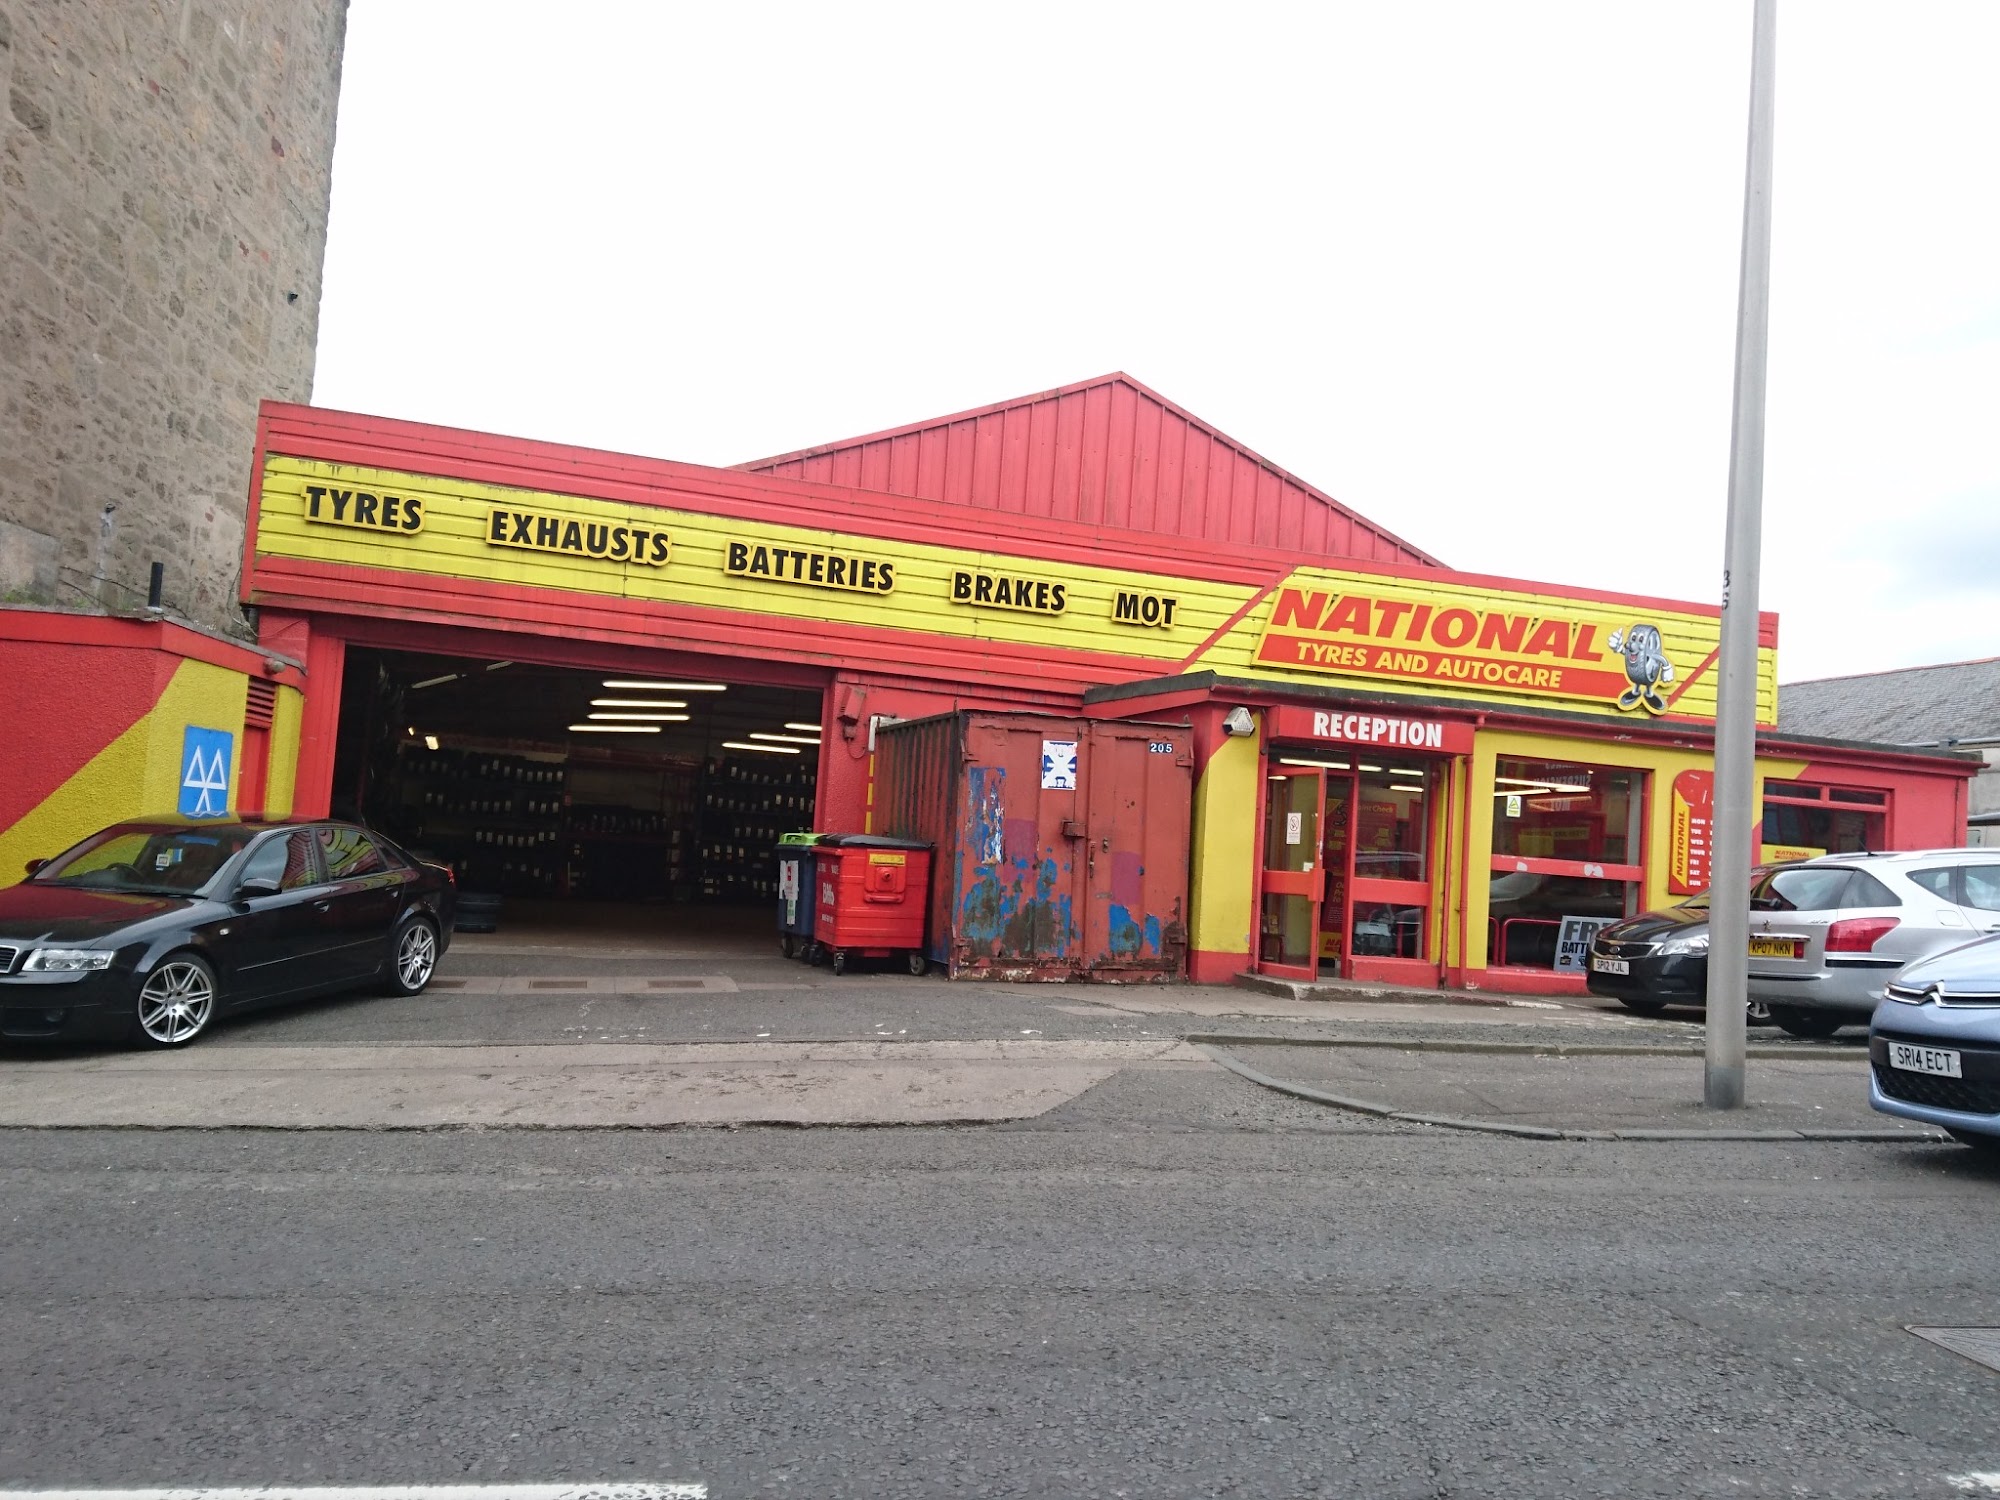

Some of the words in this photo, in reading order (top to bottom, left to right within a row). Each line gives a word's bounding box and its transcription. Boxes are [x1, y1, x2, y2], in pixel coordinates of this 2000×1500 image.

[304, 485, 423, 531] TYRES
[491, 511, 670, 564] EXHAUSTS
[728, 542, 894, 592] BATTERIES
[953, 571, 1066, 612] BRAKES
[1115, 592, 1177, 627] MOT
[1271, 588, 1604, 662] NATIONAL
[1297, 641, 1367, 668] TYRES
[1374, 653, 1429, 674] AND
[1434, 657, 1562, 688] AUTOCARE
[1313, 711, 1443, 748] RECEPTION
[1149, 743, 1173, 753] 205
[1677, 810, 1685, 876] NATIONAL
[1690, 838, 1704, 846] WED
[1775, 850, 1810, 858] NATIONAL
[1561, 941, 1589, 954] BATT
[1563, 920, 1612, 941] FR
[1751, 942, 1771, 954] KP07
[1773, 942, 1791, 955] NKN
[1611, 961, 1625, 972] YJL
[1897, 1046, 1923, 1069] SR14
[1926, 1050, 1951, 1072] ECT
